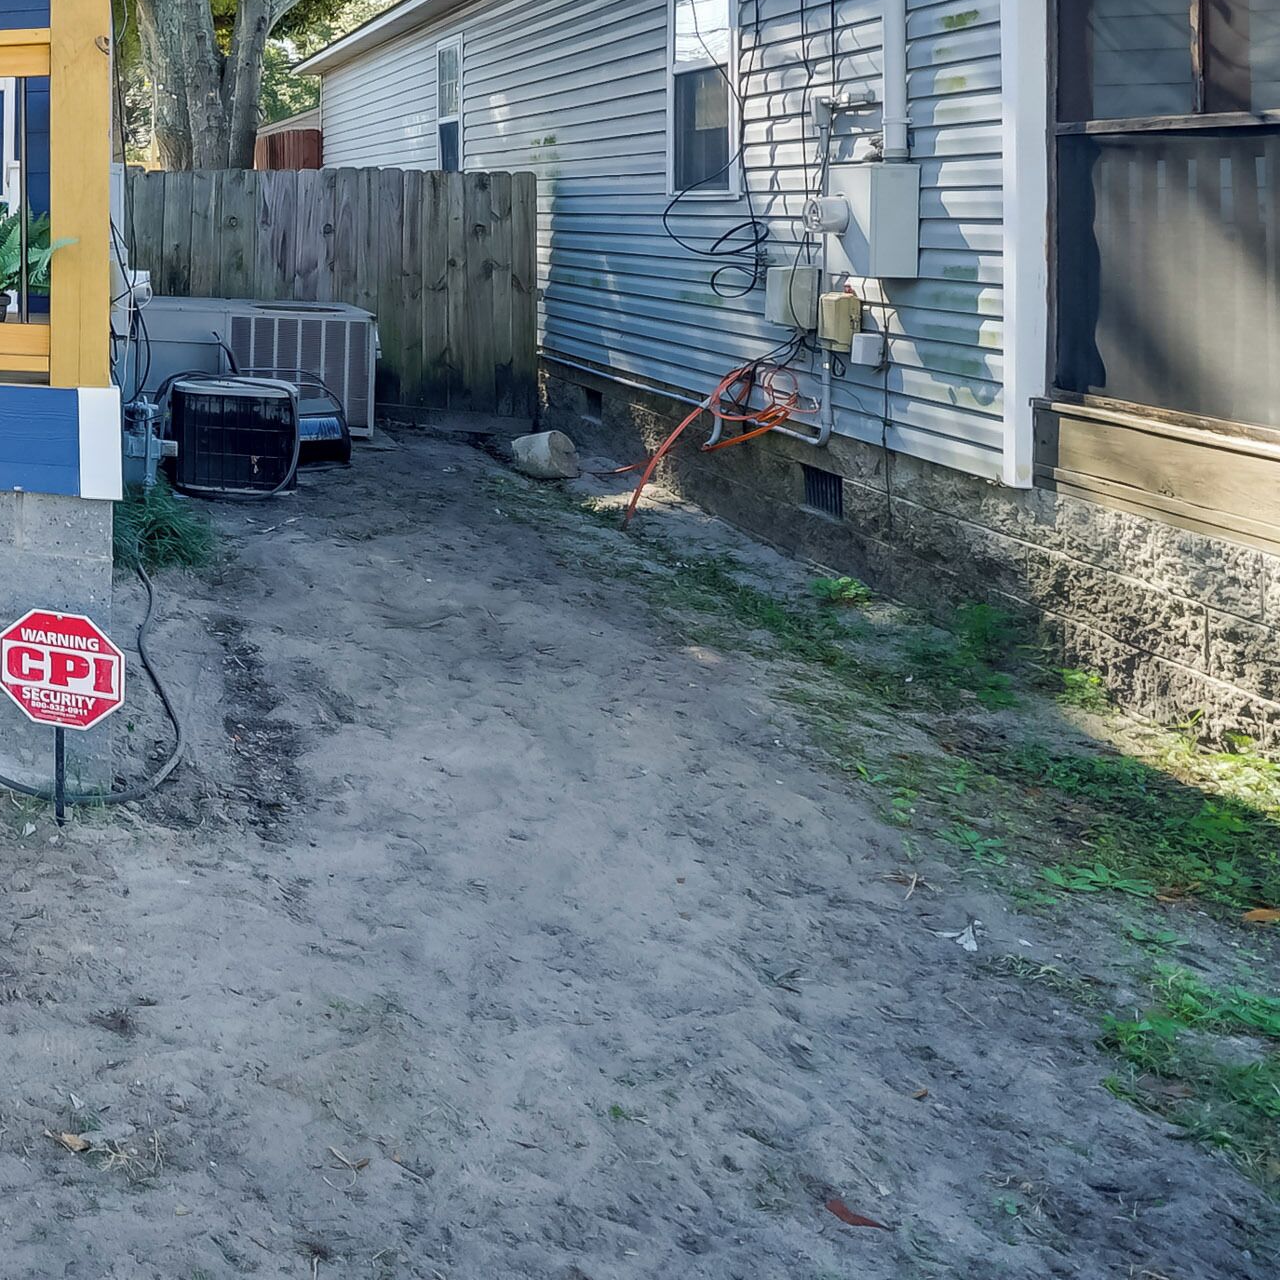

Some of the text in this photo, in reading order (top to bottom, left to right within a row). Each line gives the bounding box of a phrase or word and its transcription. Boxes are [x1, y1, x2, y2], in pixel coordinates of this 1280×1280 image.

[20, 627, 100, 651] WARNING
[7, 646, 114, 694] CPI
[21, 686, 96, 710] SECURITY
